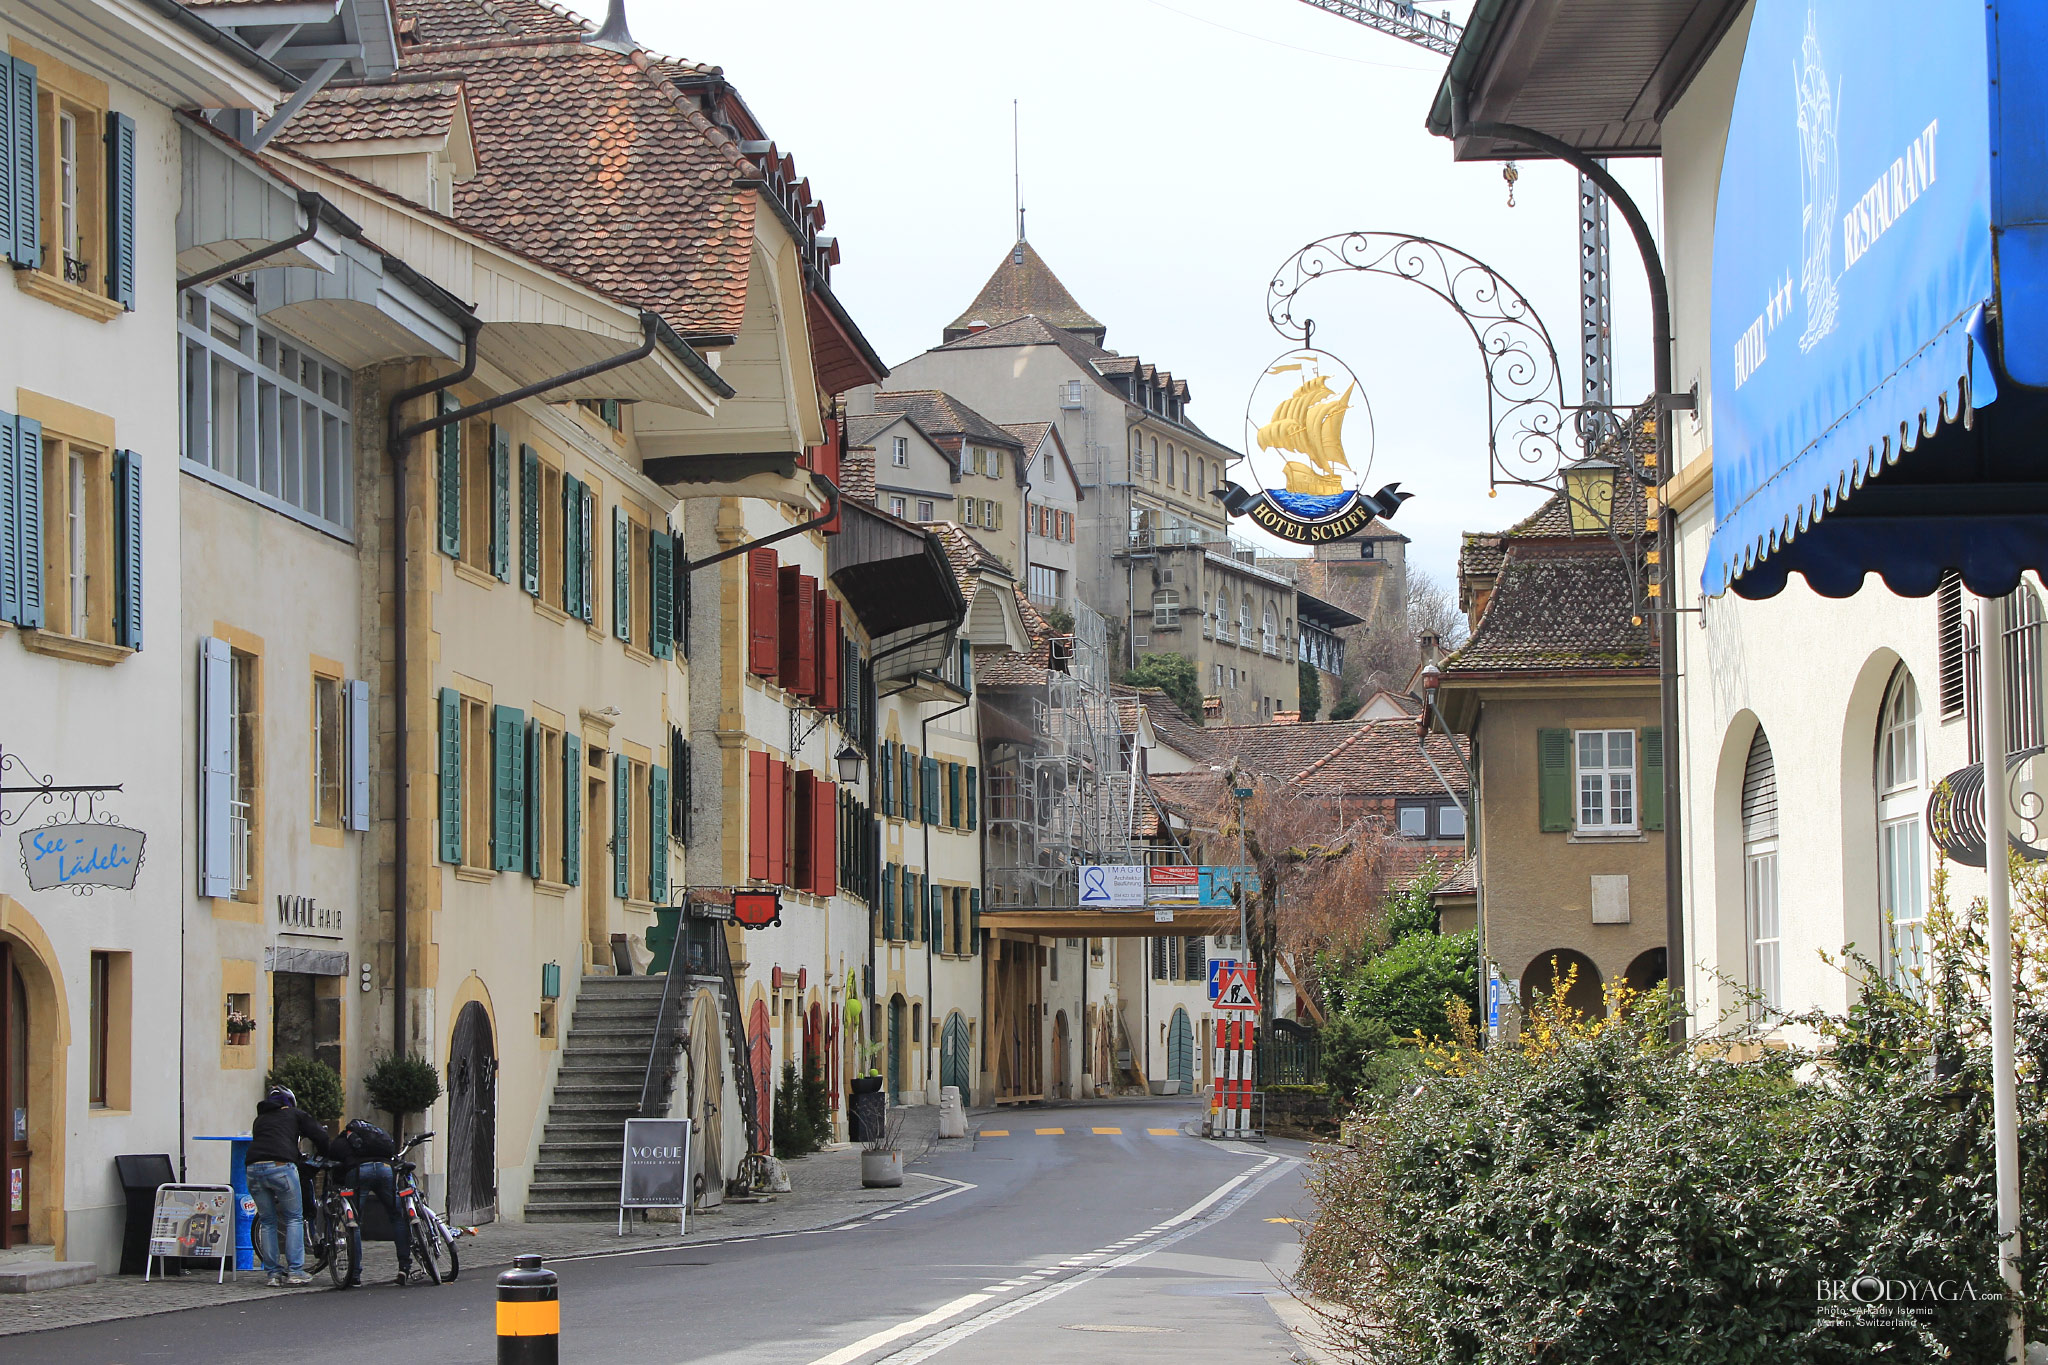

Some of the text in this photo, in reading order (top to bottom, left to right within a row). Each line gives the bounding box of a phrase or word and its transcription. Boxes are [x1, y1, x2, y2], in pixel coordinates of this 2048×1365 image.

[1734, 118, 1938, 391] HOTEL RESTAURANT
[1252, 502, 1368, 541] HOTEL SCHIFF
[59, 843, 131, 882] Lädeli
[277, 894, 342, 931] VOGUE HAIR
[631, 1146, 682, 1158] VOGUE
